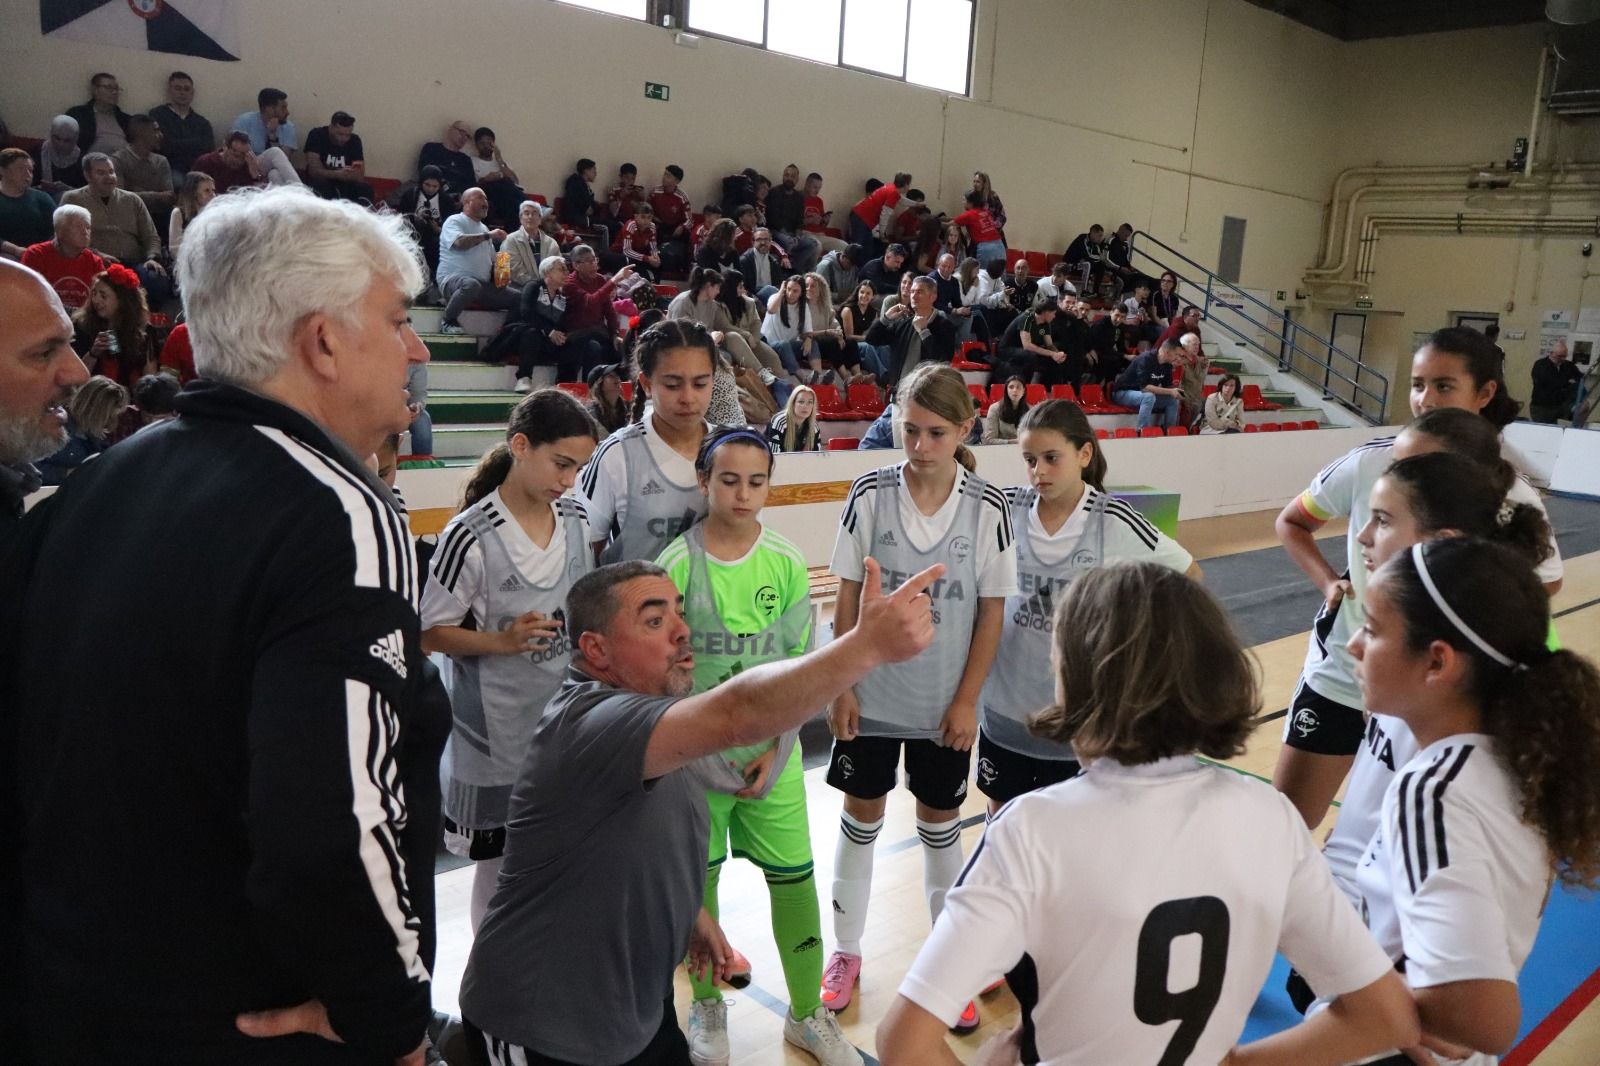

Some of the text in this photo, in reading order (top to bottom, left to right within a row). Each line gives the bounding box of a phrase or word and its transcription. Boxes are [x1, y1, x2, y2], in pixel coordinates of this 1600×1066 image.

[326, 154, 346, 168] HH
[1013, 611, 1054, 633] adida
[531, 636, 572, 664] adida
[691, 631, 778, 656] CEUTA
[369, 644, 408, 679] adidas
[1134, 895, 1231, 1066] 9
